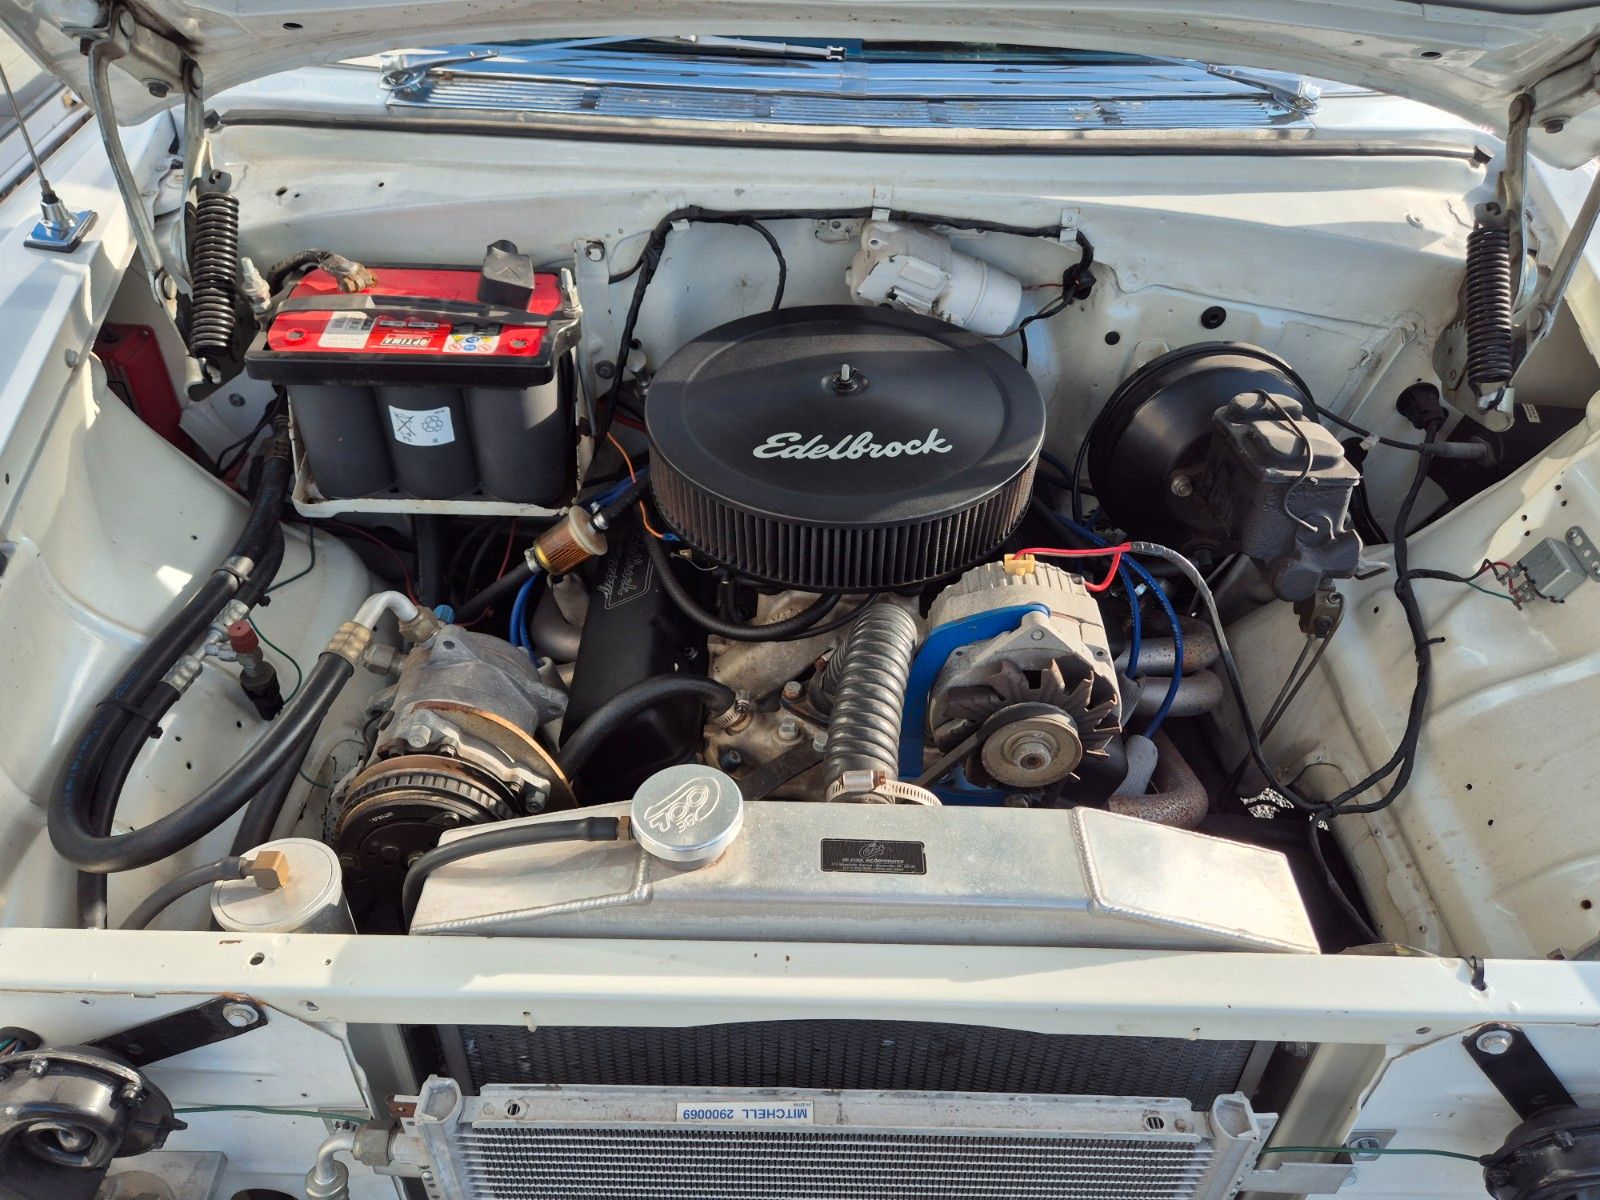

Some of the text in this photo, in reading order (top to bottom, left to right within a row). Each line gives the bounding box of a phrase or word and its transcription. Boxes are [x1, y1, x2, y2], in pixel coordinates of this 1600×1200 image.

[382, 338, 429, 347] OPTIMA
[753, 428, 952, 460] Edelbrock
[683, 1108, 808, 1120] MITCHELL 2900069
